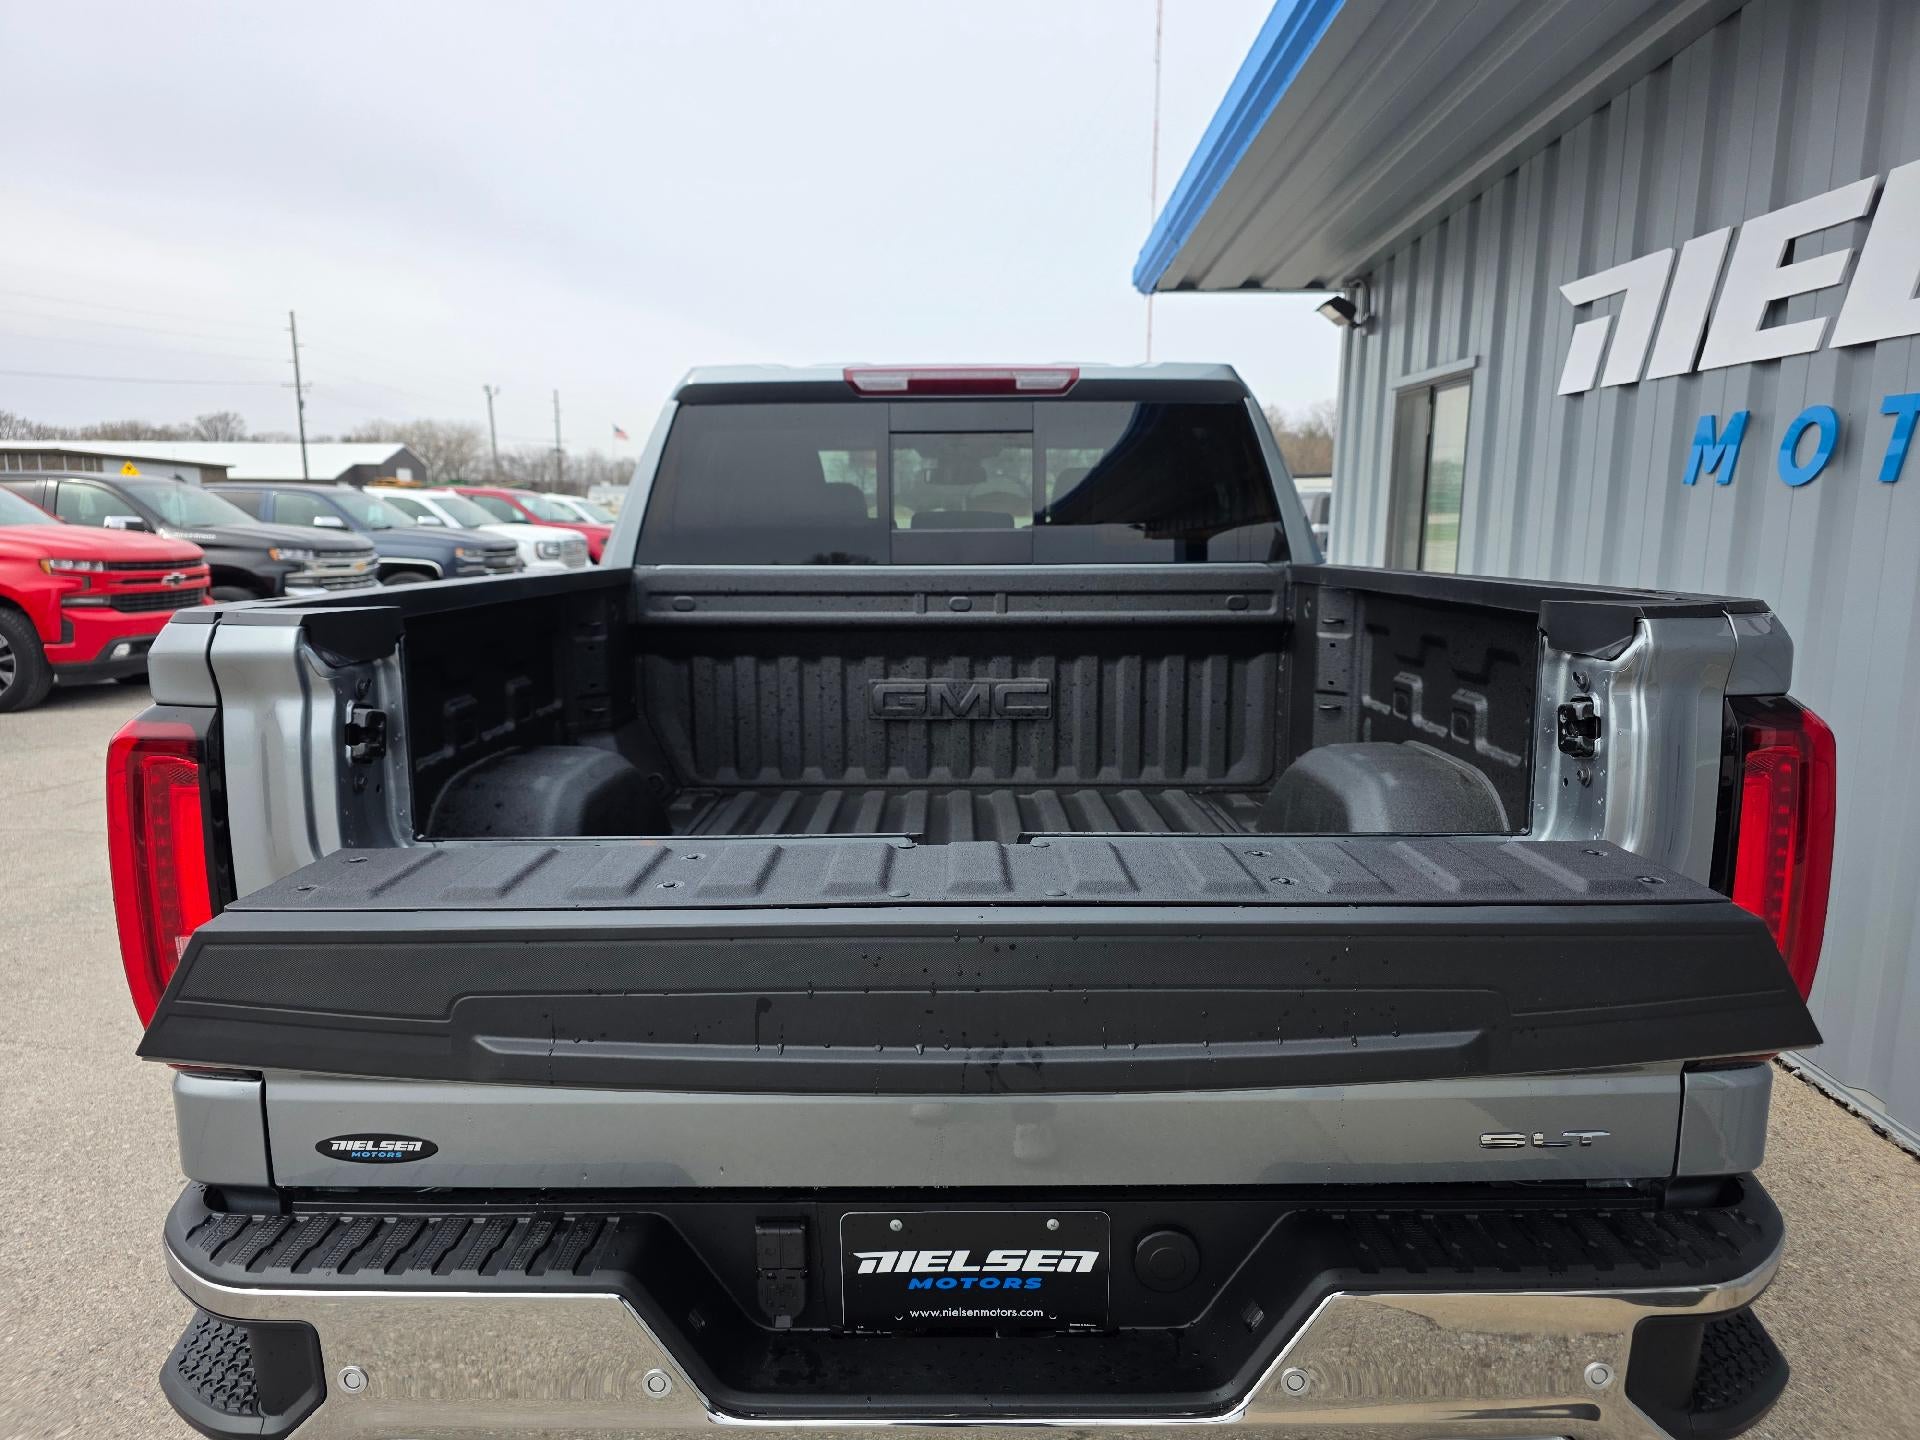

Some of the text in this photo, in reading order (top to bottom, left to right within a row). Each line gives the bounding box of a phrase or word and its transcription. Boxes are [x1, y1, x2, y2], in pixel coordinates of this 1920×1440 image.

[872, 683, 1049, 717] GMC
[329, 1140, 423, 1151] NIELSEN
[1480, 1130, 1611, 1148] SLT
[853, 1250, 1100, 1274] NIELSEN
[908, 1277, 1042, 1290] MOTORS
[909, 1307, 1044, 1318] www.nielsenmotors.com
